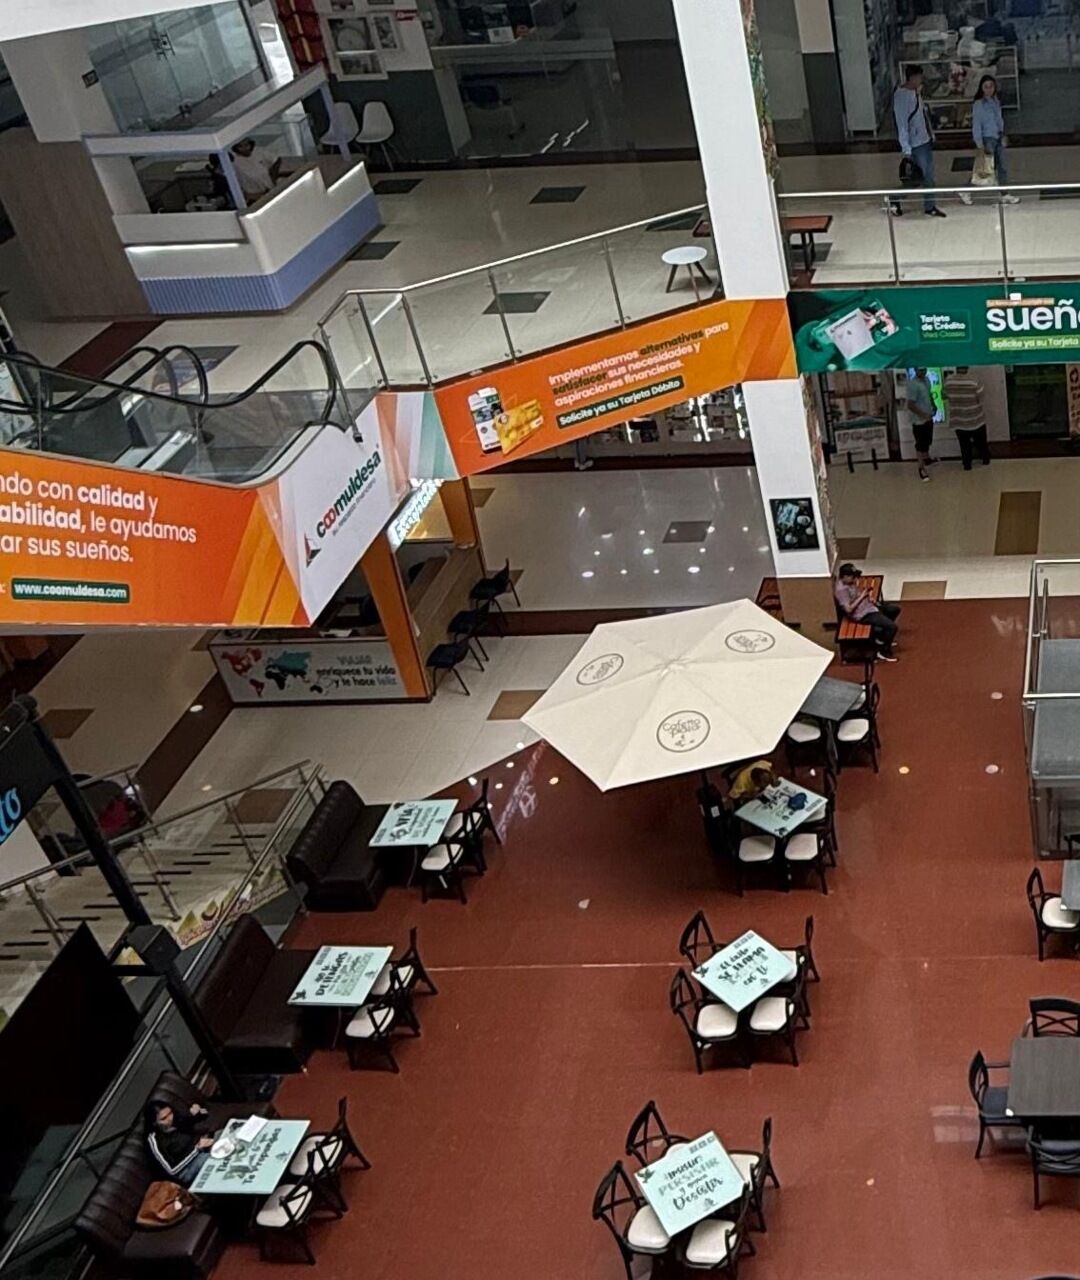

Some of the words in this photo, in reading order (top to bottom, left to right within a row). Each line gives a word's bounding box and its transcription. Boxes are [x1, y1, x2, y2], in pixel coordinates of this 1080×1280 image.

[549, 350, 640, 386] Implementamos
[639, 330, 704, 356] alternativas
[705, 322, 729, 338] para
[991, 337, 1023, 349] Solicite
[1024, 339, 1035, 350] ya
[1036, 338, 1047, 347] su
[1048, 337, 1079, 348] Tarjeta
[553, 371, 608, 396] satisfacer
[607, 366, 626, 378] sus
[628, 344, 693, 371] necesidades
[694, 342, 701, 354] y
[554, 379, 624, 407] aspiraciones
[624, 359, 684, 385] financieras.
[559, 408, 593, 426] Solicite
[593, 404, 606, 416] ya
[607, 400, 618, 411] su
[619, 389, 651, 409] Tarjeta
[651, 380, 681, 395] Débito
[37, 480, 73, 501] con
[77, 484, 145, 511] calidad
[148, 495, 158, 518] y
[316, 451, 382, 538] coomuldesa
[90, 510, 106, 532] le
[110, 517, 197, 543] ayudamos
[27, 537, 61, 557] sus
[65, 539, 134, 562] sueños.
[14, 583, 127, 598] www.coomuldesa.com
